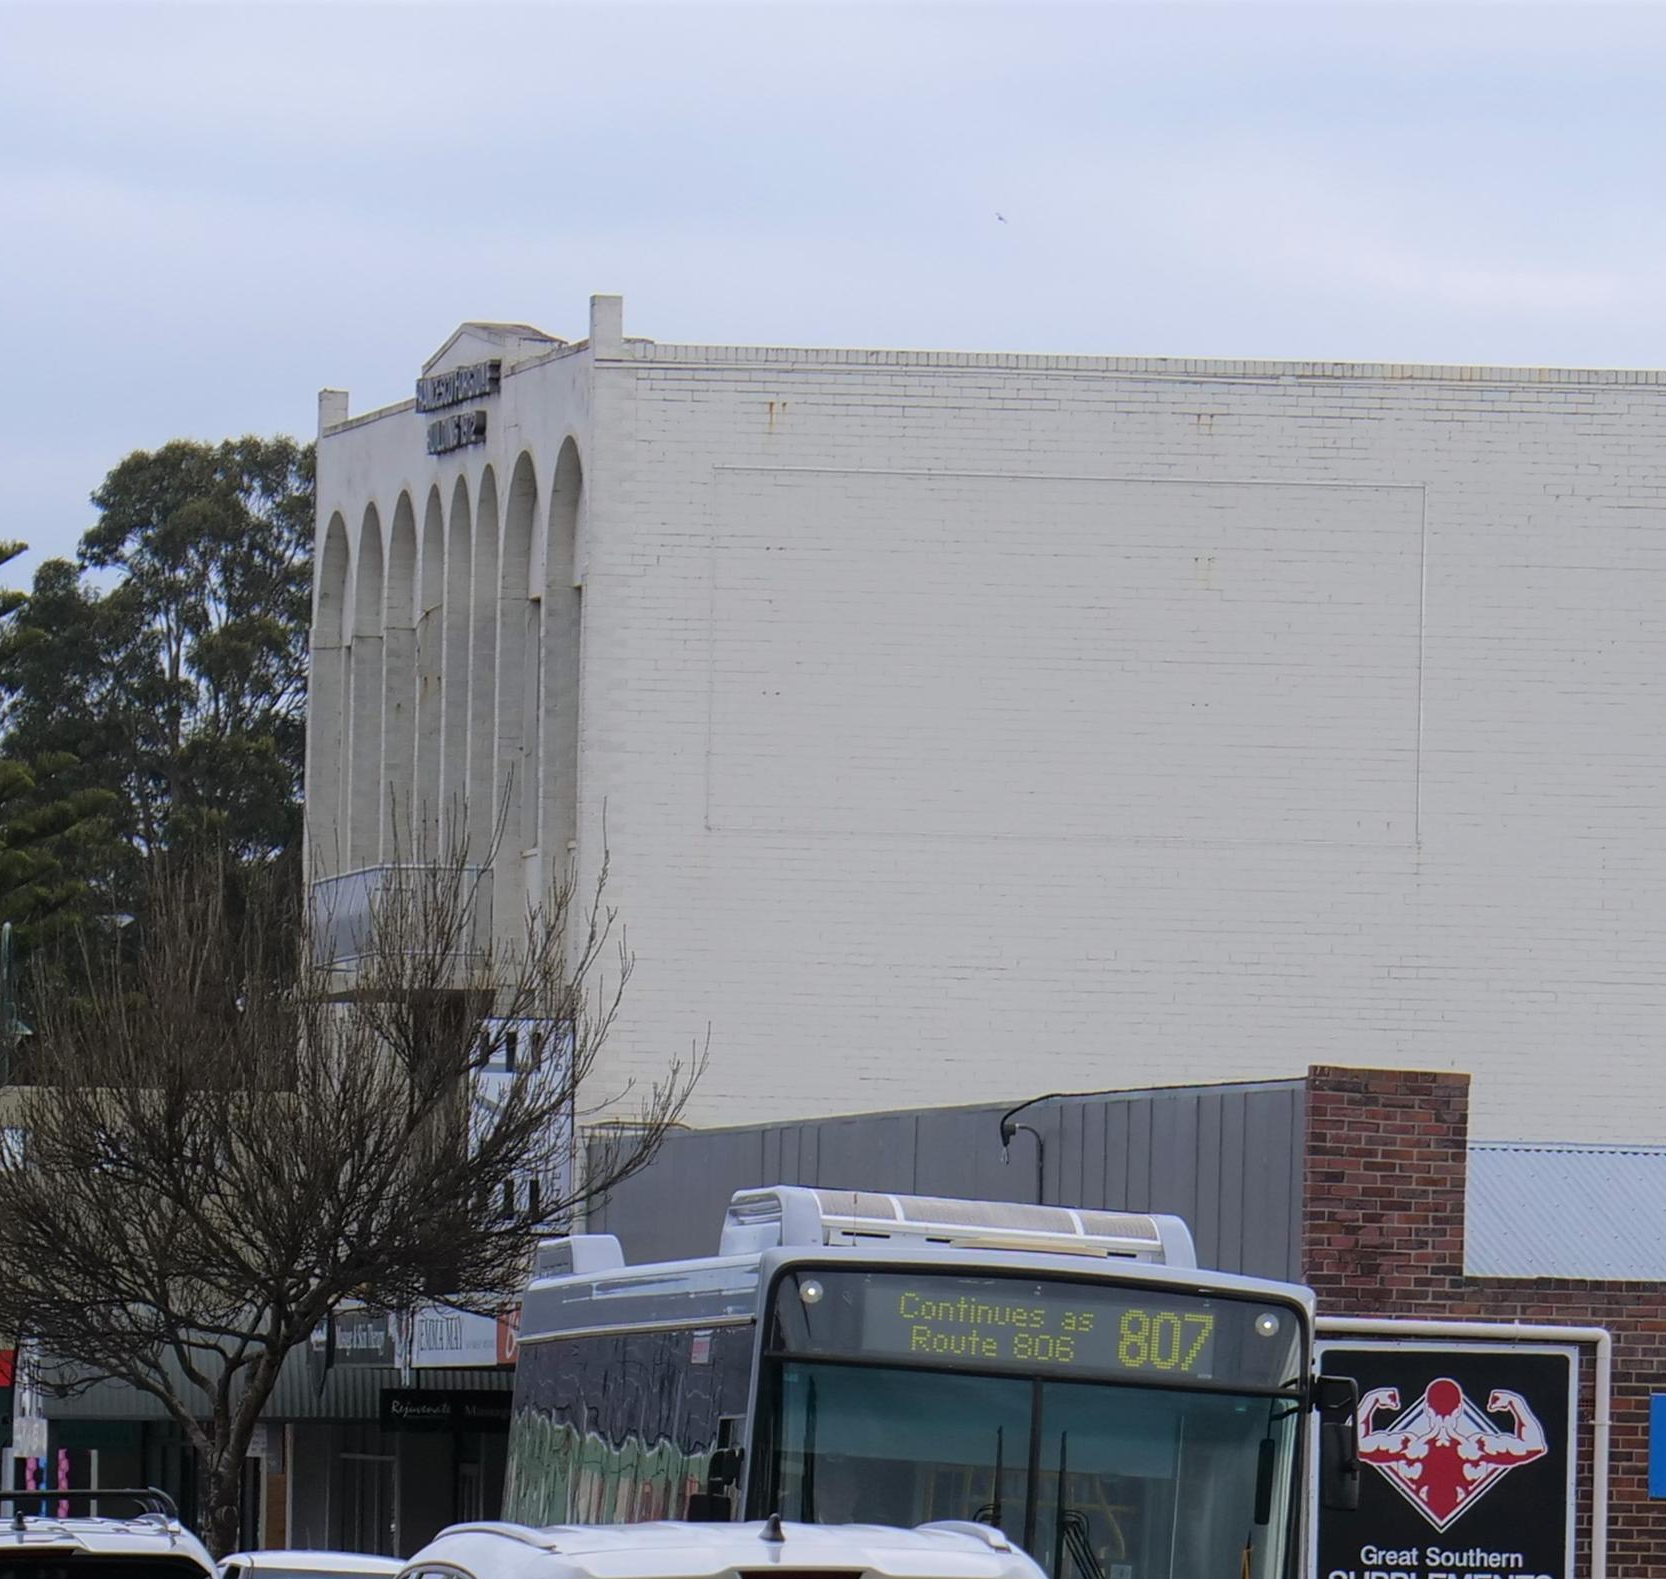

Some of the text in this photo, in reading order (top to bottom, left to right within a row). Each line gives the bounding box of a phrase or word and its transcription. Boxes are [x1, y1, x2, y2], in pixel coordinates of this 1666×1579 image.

[899, 1291, 1095, 1333] Continues as
[910, 1324, 1076, 1363] Route 806
[1117, 1308, 1215, 1372] 807
[1360, 1545, 1523, 1567] Great Southern
